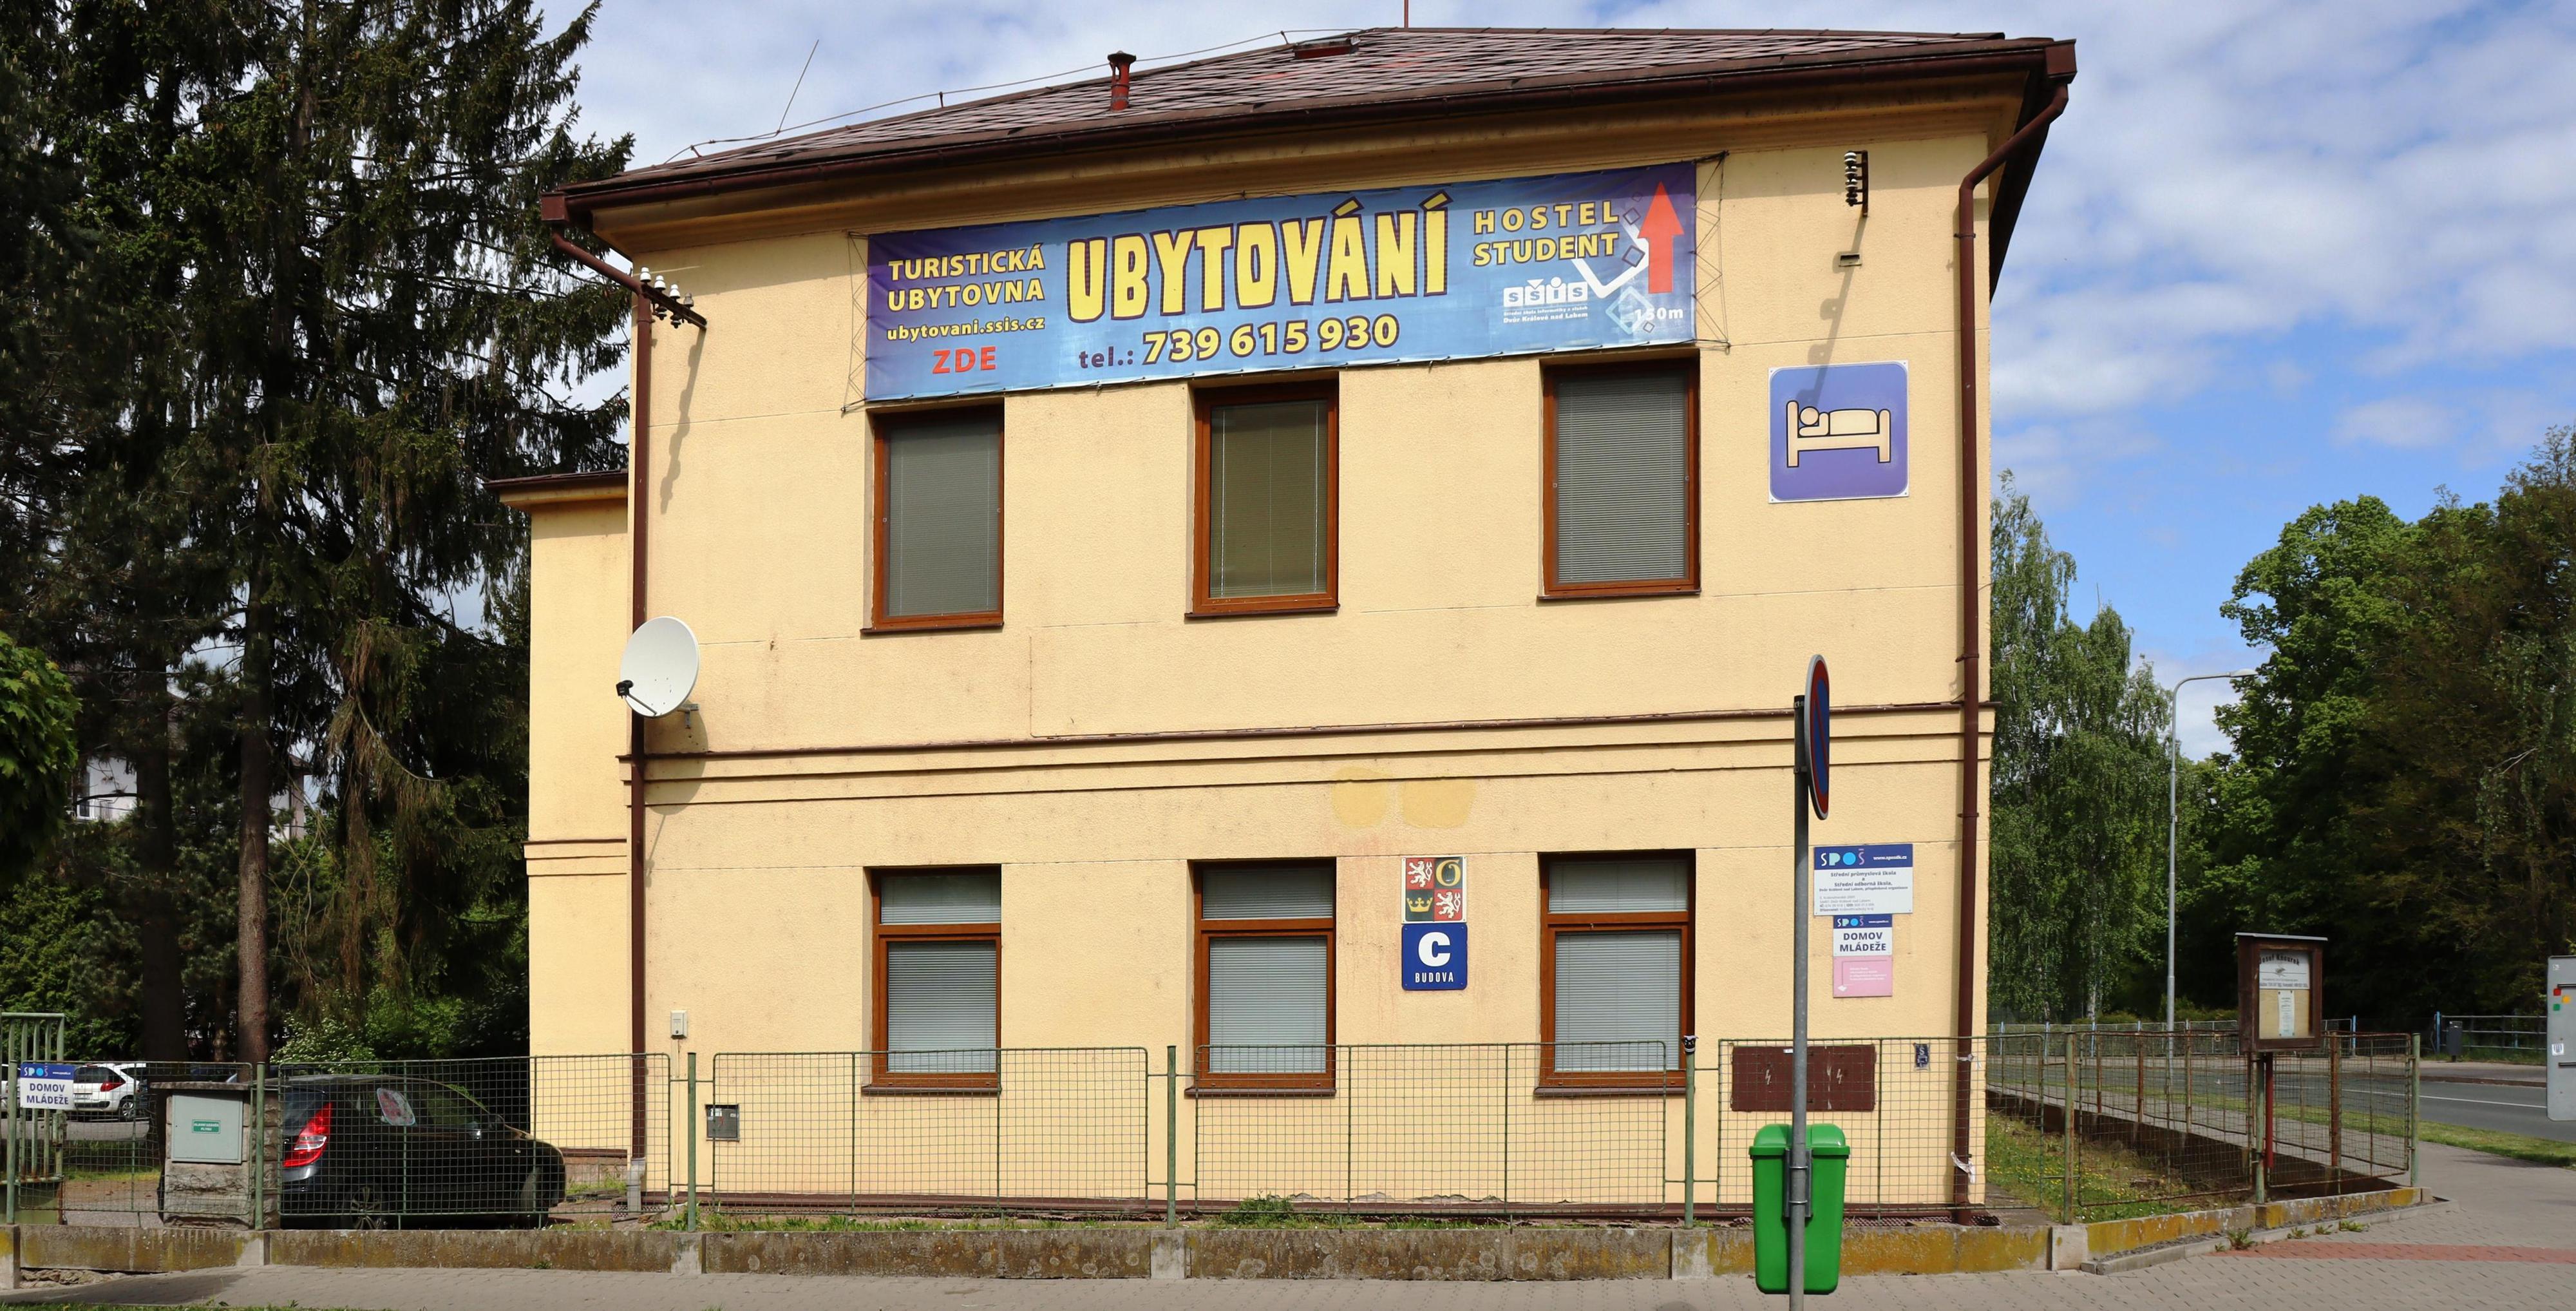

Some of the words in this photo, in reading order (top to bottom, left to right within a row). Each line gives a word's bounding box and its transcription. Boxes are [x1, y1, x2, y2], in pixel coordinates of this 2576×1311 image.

[1473, 200, 1620, 235] HOSTEL
[888, 243, 1045, 281] TURISTICKÁ
[1066, 189, 1452, 322] UBYTOVÁNÍ
[1473, 231, 1620, 267] STUDENT
[887, 278, 1045, 312] UBYTOVNA
[887, 316, 1045, 343] ubytovani.ssis.cz
[1079, 346, 1134, 368] tel.:
[1142, 327, 1221, 365] 739
[1229, 321, 1309, 358] 615
[1317, 314, 1400, 352] 930
[933, 346, 996, 374] ZDE
[1418, 932, 1451, 967] C
[1840, 941, 1886, 952] MLÁDEŽE
[1844, 932, 1883, 941] DOMOV
[1415, 972, 1454, 983] BUDOVA
[26, 1093, 69, 1105] MLÁDEŽE
[30, 1083, 65, 1093] DOMOV
